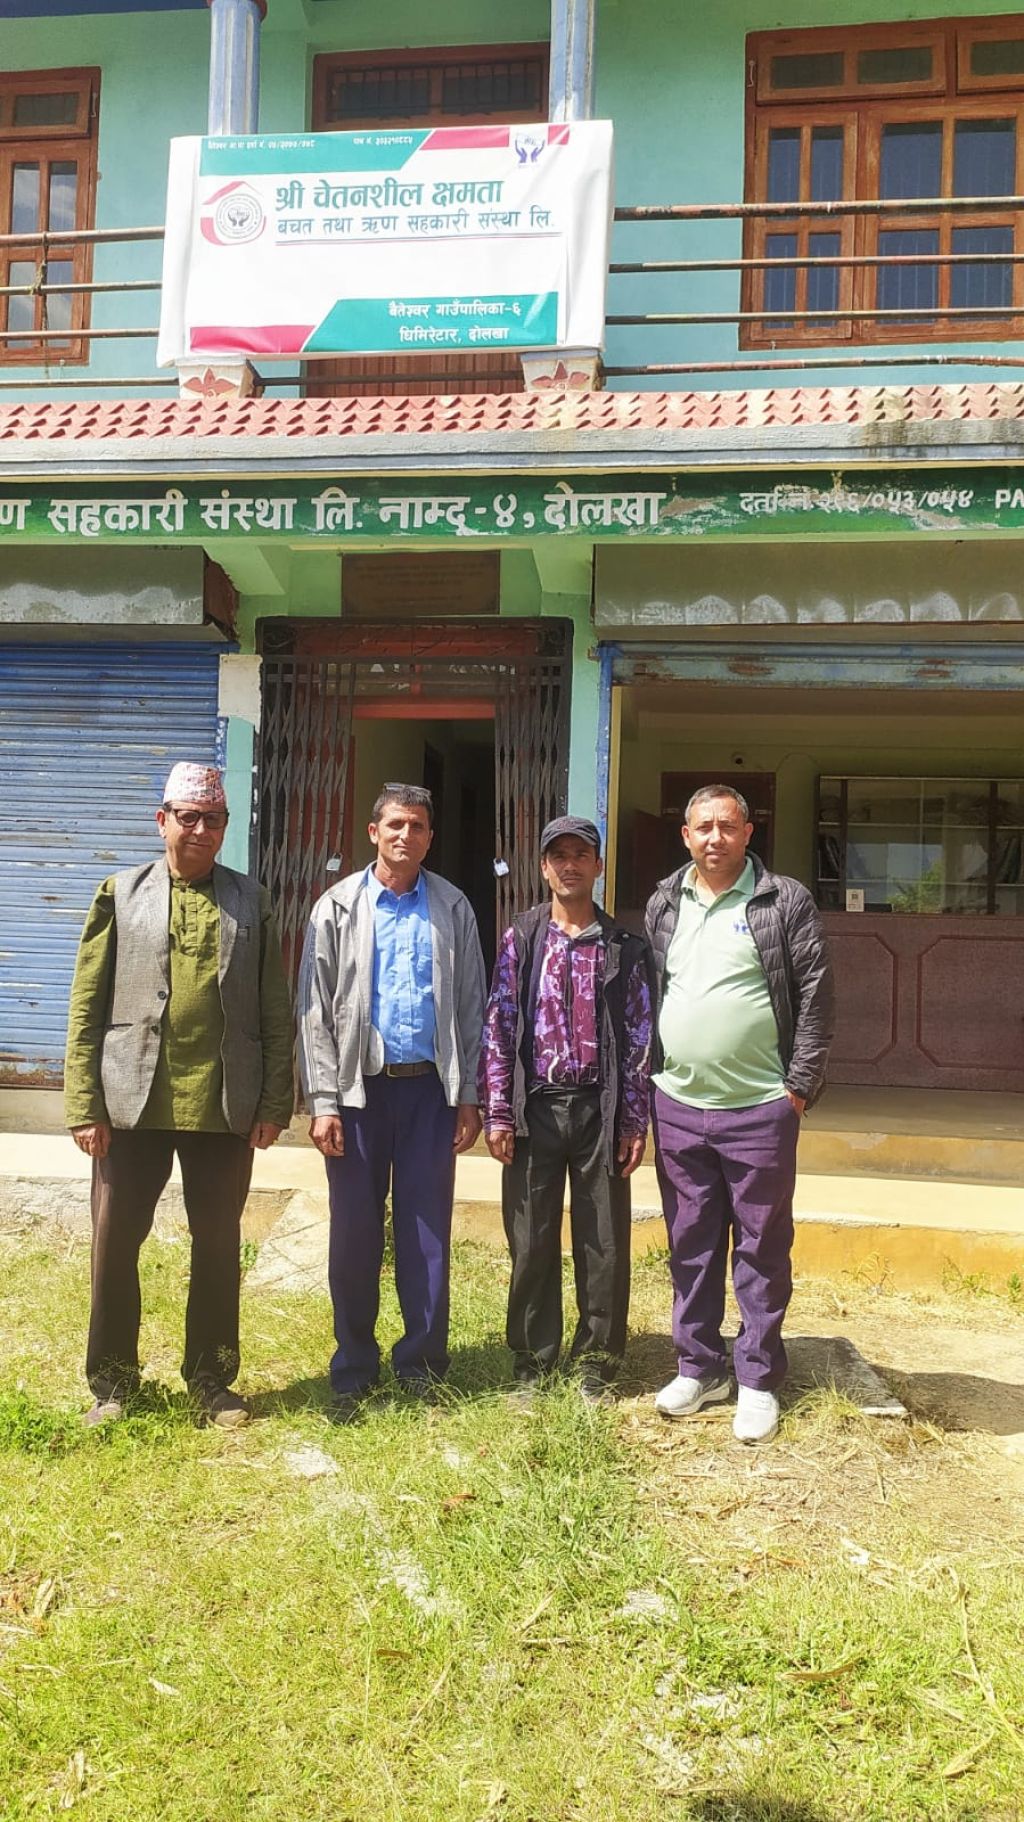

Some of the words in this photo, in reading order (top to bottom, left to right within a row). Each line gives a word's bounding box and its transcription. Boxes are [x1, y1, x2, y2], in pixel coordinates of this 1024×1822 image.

[275, 180, 305, 211] श्री
[313, 177, 425, 210] चेतनशील
[431, 180, 504, 207] क्षमता
[277, 218, 314, 235] बचत
[322, 217, 354, 234] तथा
[361, 215, 399, 234] ऋण
[407, 208, 469, 234] सहकारी
[478, 208, 521, 232] संस्था
[529, 205, 555, 228] लि.
[468, 325, 510, 341] दोलखा
[48, 489, 188, 537] सहकारी
[200, 489, 297, 531] संस्था
[312, 487, 363, 531] लि.
